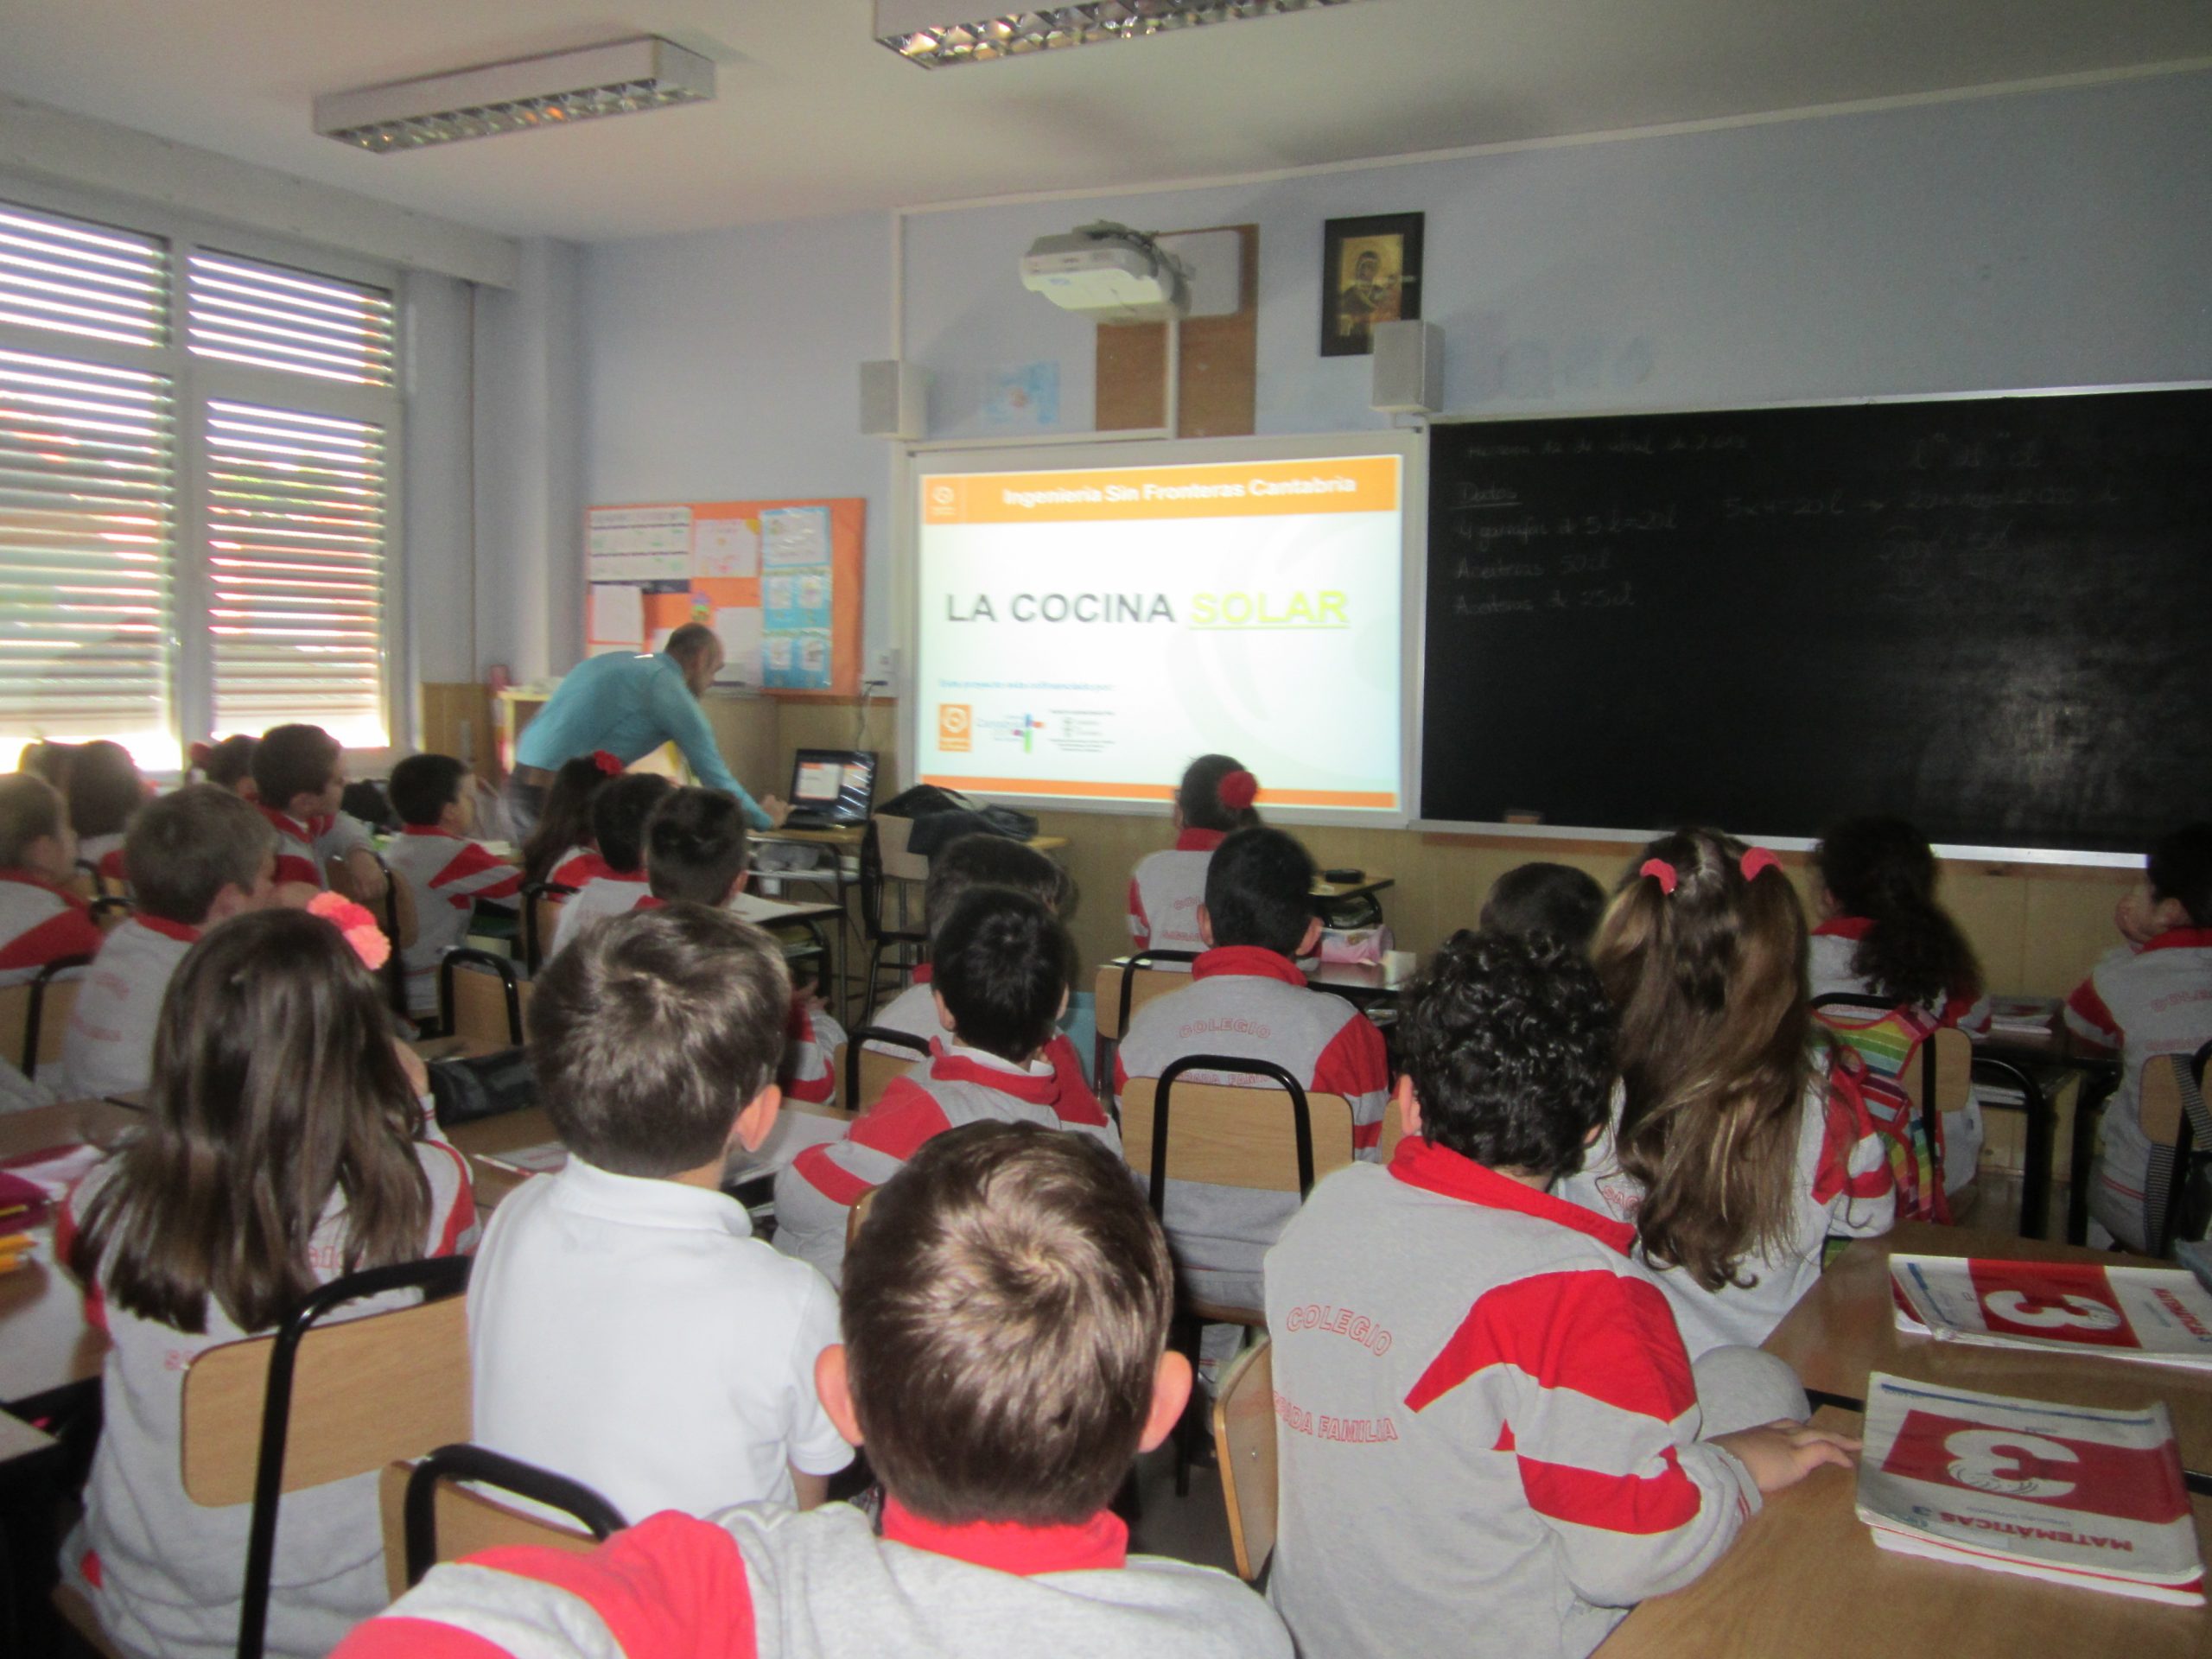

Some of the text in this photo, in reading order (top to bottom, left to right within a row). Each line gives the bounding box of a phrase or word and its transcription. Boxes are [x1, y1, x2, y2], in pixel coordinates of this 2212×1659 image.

[1104, 483, 1139, 503] Sin
[1141, 482, 1246, 501] Fronteras
[1248, 474, 1357, 497] Cantabria
[946, 590, 1350, 626] LA COCINA SOLAR
[1179, 1018, 1272, 1039] COLEGIO
[1286, 1305, 1393, 1357] COLEGIO
[1317, 1415, 1399, 1443] FAMILIA
[1943, 1429, 2080, 1497] 3
[1941, 1512, 2133, 1552] MATEMÁTICAS
